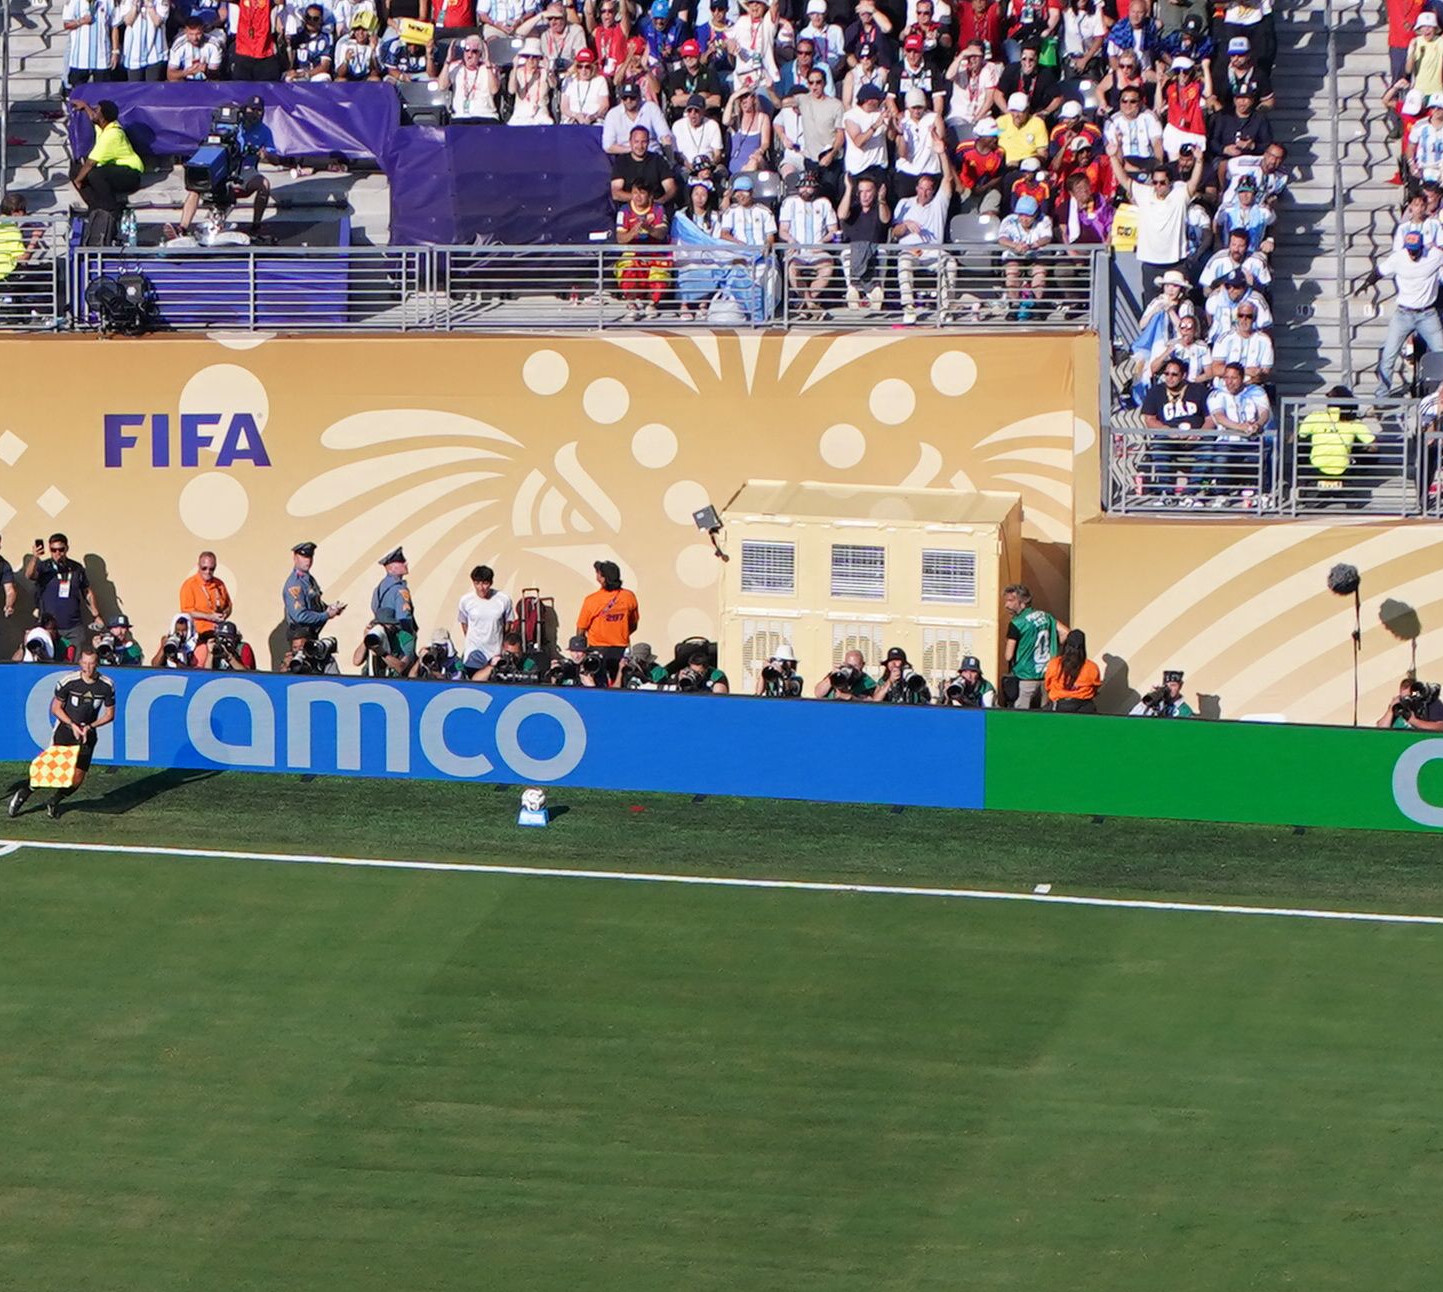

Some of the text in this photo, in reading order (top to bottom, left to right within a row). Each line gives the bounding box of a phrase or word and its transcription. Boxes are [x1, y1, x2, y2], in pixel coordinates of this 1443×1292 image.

[1163, 398, 1198, 421] GAP
[104, 413, 271, 467] FIFA
[25, 670, 587, 781] aramco
